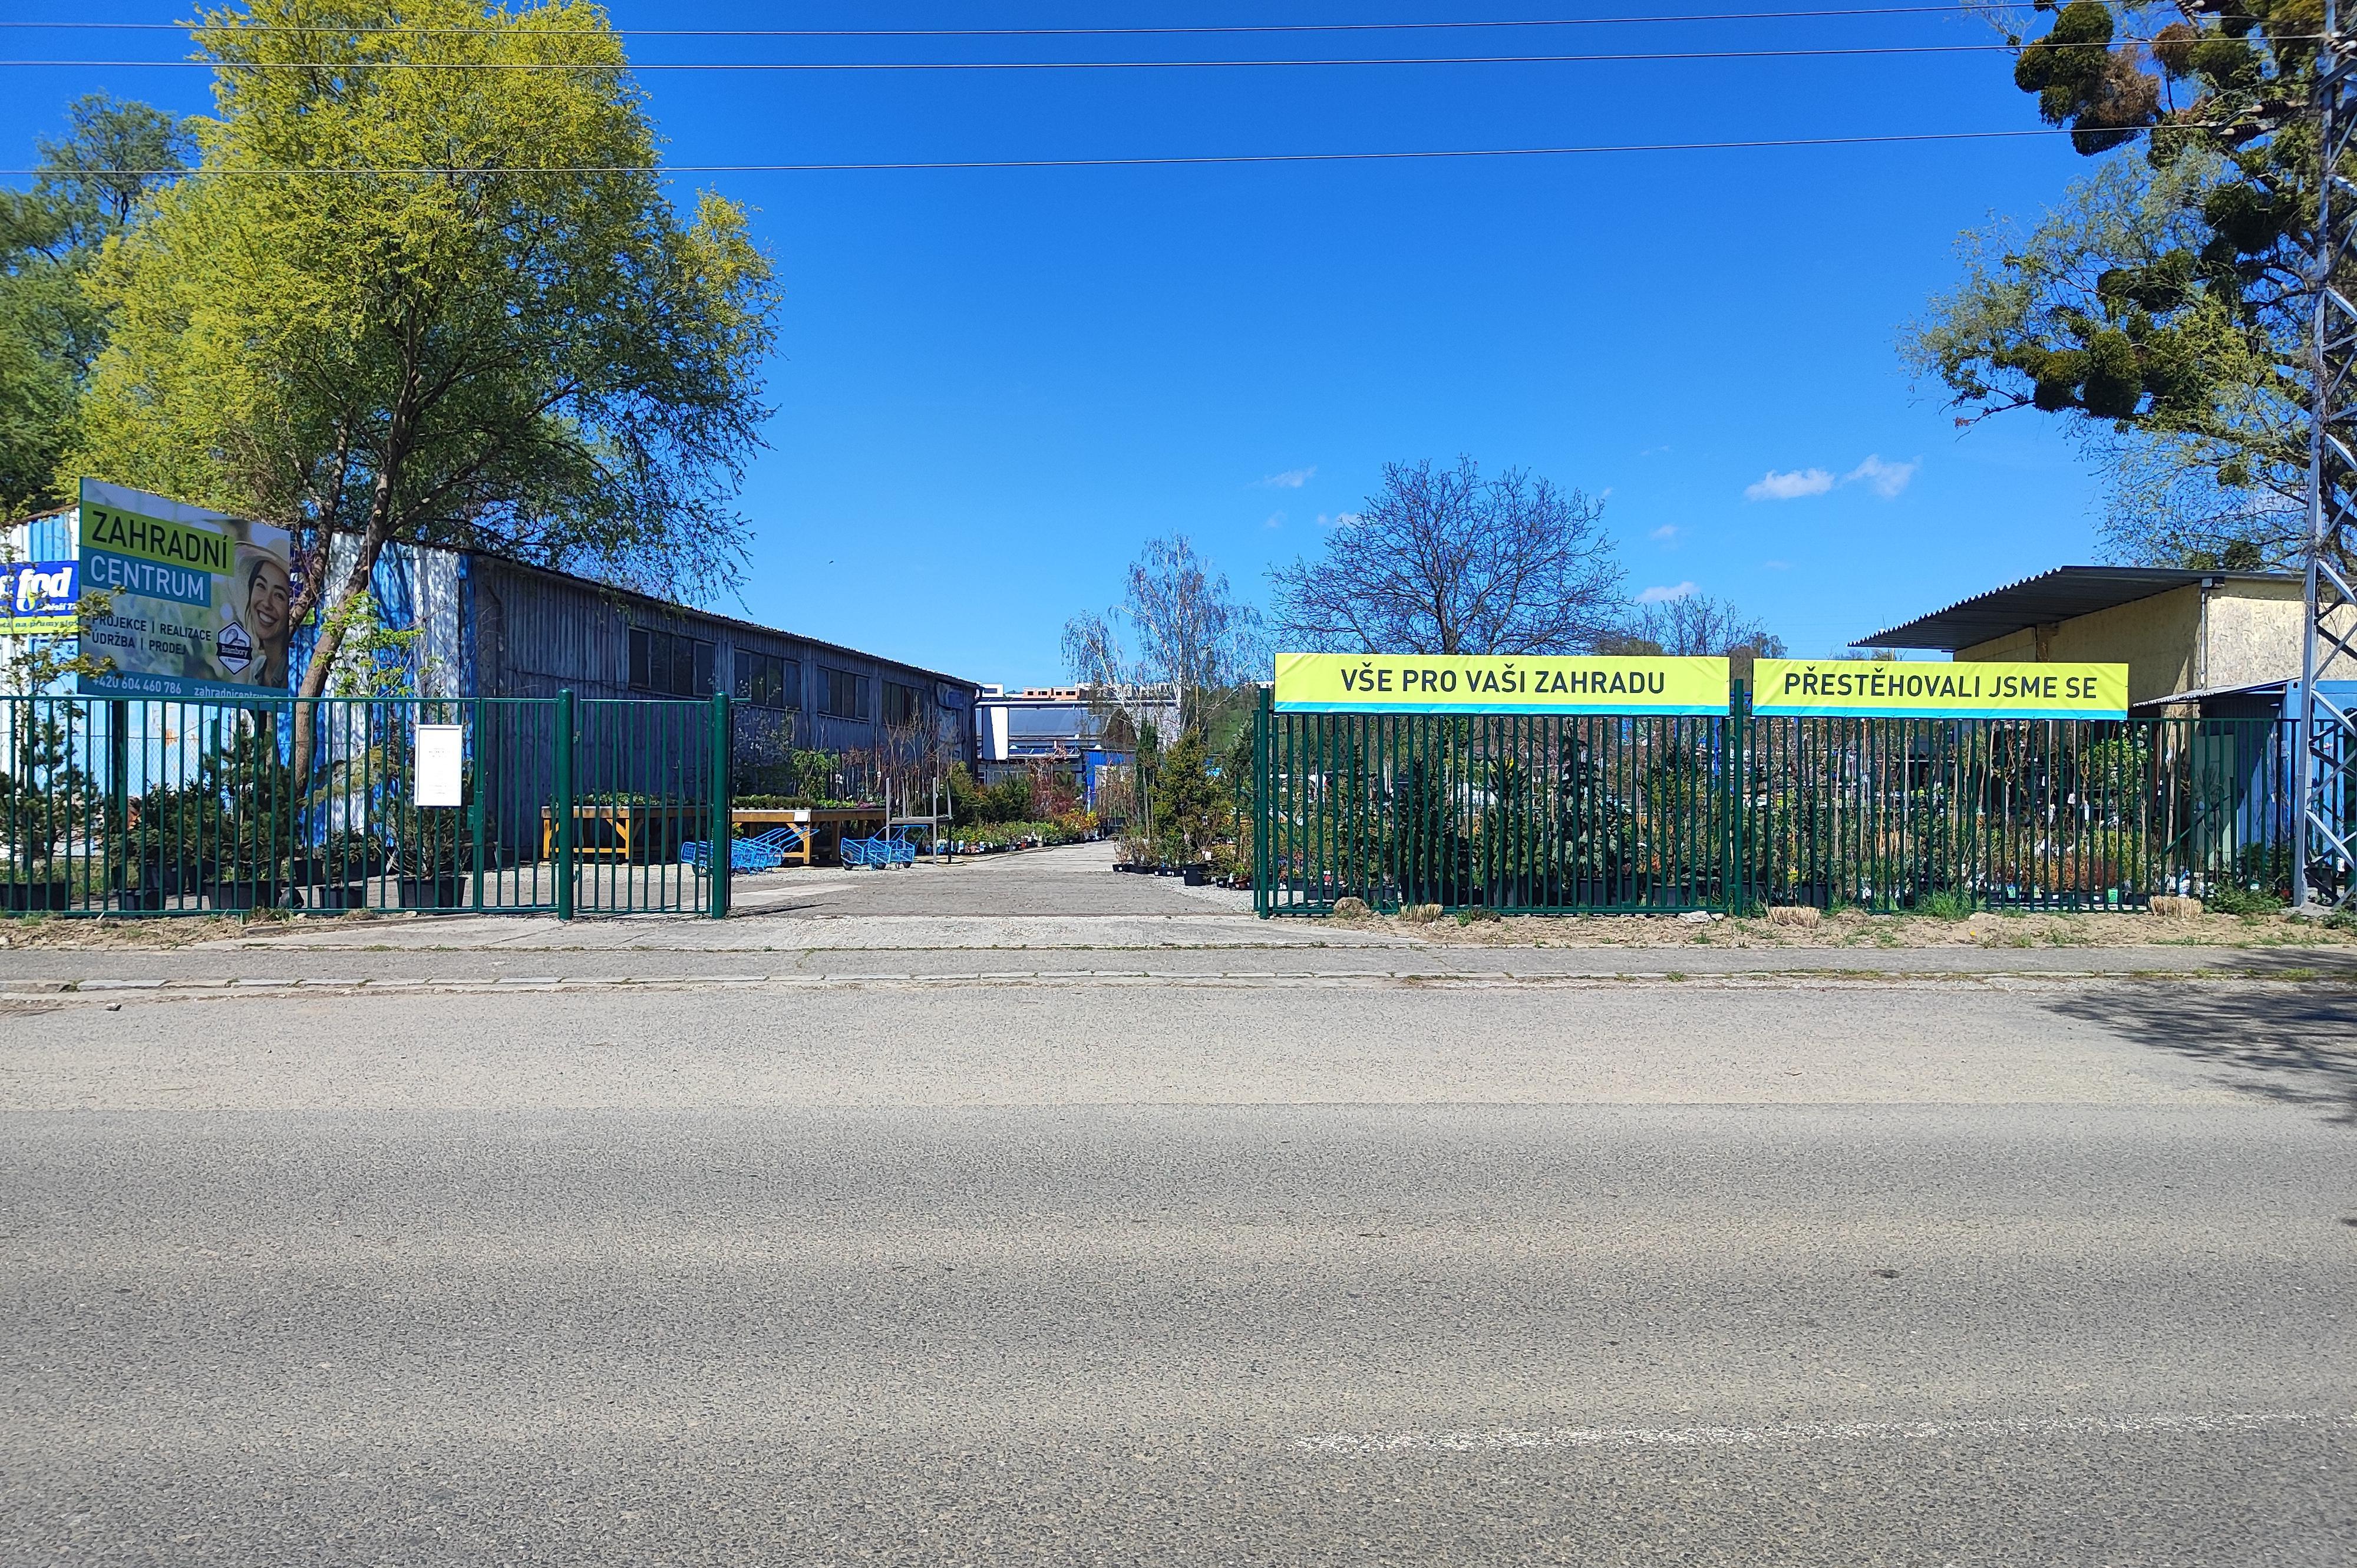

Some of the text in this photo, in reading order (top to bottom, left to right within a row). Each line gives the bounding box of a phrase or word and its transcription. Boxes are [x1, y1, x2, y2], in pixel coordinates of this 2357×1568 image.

[92, 510, 227, 569] ZAHRADNÍ
[91, 555, 203, 600] CENTRUM
[92, 615, 212, 641] PROJEKCE REALIZACE
[92, 628, 187, 655] ÚDRŽBA PRODEJ
[92, 675, 118, 688] +420
[121, 677, 141, 691] 604
[143, 679, 161, 692] 460
[164, 681, 181, 695] 786
[1341, 662, 1664, 694] VŠE PRO VAŠI ZAHRADU
[1785, 666, 2097, 698] PŘESTĚHOVALI JSME SE
